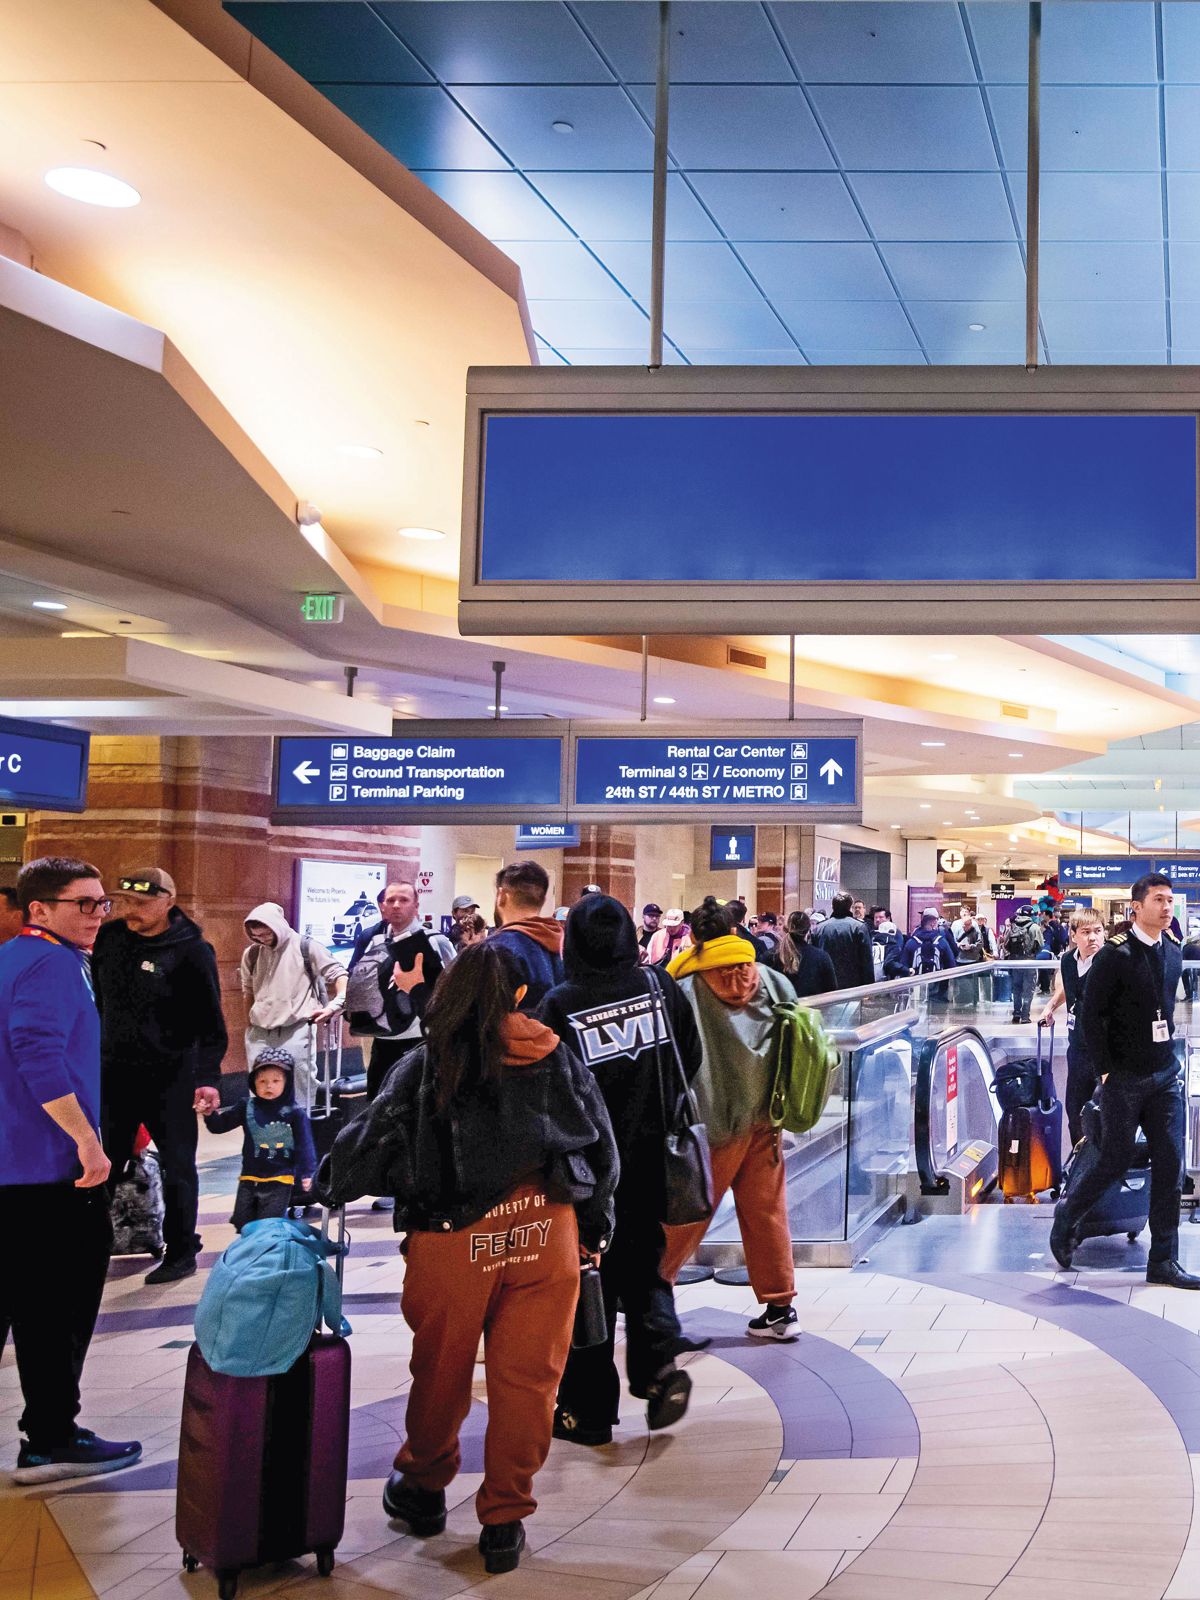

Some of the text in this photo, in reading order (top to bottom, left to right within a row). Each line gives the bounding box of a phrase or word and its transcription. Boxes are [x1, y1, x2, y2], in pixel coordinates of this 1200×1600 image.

[305, 596, 336, 620] EXIT
[353, 745, 456, 761] Baggage Claim
[667, 745, 786, 758] Rental Car Center
[8, 753, 22, 773] C
[352, 765, 505, 781] Ground Transportation
[619, 765, 676, 779] Terminal
[679, 766, 688, 778] 3
[713, 765, 720, 778] /
[722, 765, 785, 781] Economy
[352, 785, 410, 798] Terminal
[413, 785, 465, 801] Parking
[605, 786, 785, 799] 24th ST / 44th ST / METRO
[530, 827, 565, 836] WOMEN
[725, 853, 741, 862] MEN
[586, 1008, 619, 1024] SAVAGE
[534, 1194, 546, 1208] OF
[470, 1218, 552, 1262] FENTY
